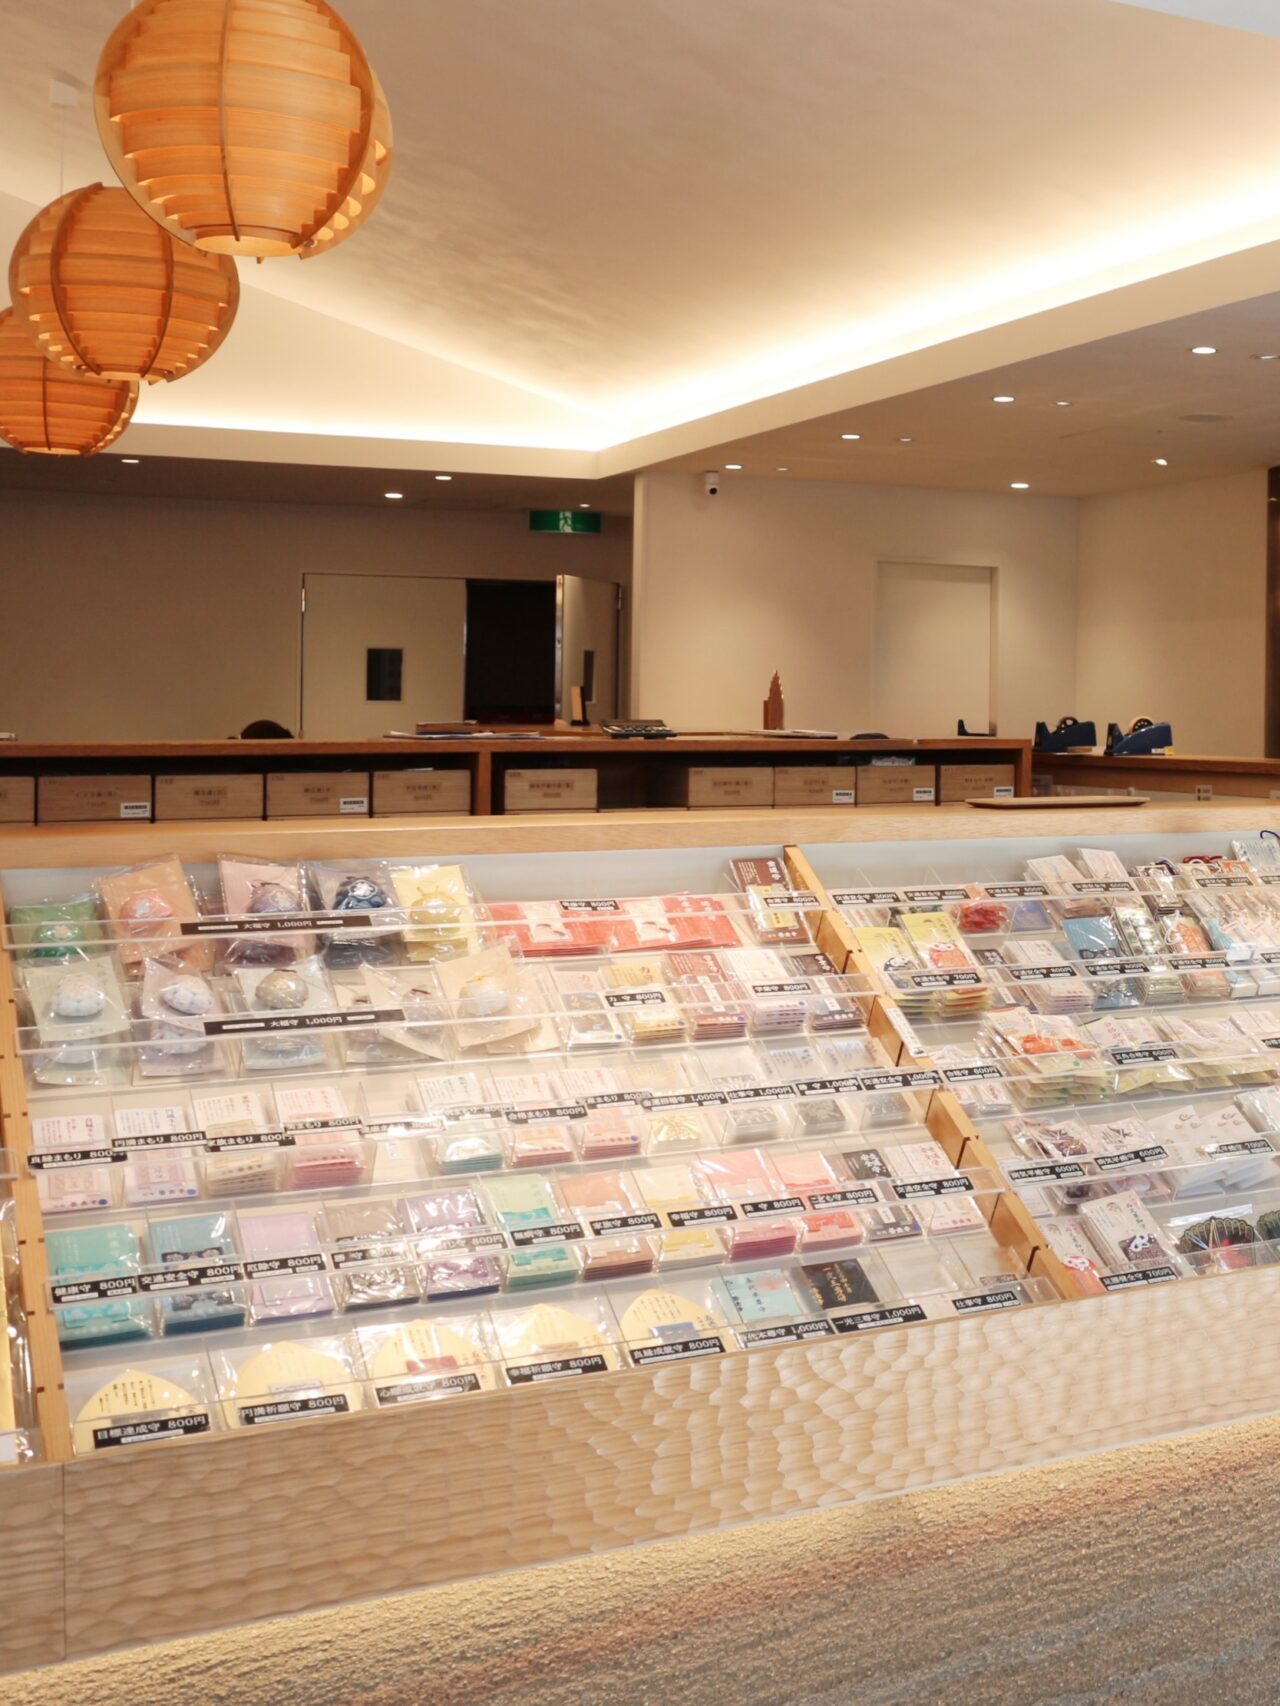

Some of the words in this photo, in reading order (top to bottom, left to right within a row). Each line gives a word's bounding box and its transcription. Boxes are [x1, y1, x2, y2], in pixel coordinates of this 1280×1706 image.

[244, 921, 270, 929] 大福守
[277, 920, 312, 928] 1,000円
[270, 1019, 298, 1027] 大福守
[306, 1016, 342, 1025] 1,000円
[690, 1092, 724, 1102] 1,000円
[759, 1086, 791, 1096] 1,000円
[556, 1106, 585, 1116] 800円
[170, 1131, 204, 1142] 800円
[1055, 1164, 1079, 1173] 600円
[897, 1182, 938, 1194] 交通安全守
[943, 1178, 968, 1188] 800円
[773, 1198, 801, 1208] 800円
[811, 1193, 841, 1204] こども守
[847, 1190, 872, 1200] 800円
[705, 1205, 732, 1216] 800円
[628, 1214, 657, 1225] 800円
[550, 1224, 579, 1235] 800円
[287, 1255, 321, 1267] 800円
[141, 1270, 199, 1285] 交通安全守
[206, 1263, 242, 1276] 800円
[54, 1284, 91, 1297] 健康守
[99, 1277, 135, 1290] 800円
[956, 1298, 982, 1308] 仕事守
[986, 1292, 1013, 1303] 800円
[885, 1307, 921, 1319] 1,000円
[791, 1322, 828, 1334] 1,000円
[689, 1338, 719, 1350] 800円
[569, 1356, 602, 1369] 800円
[443, 1375, 476, 1388] 800円
[241, 1402, 301, 1418] 円満祈願守
[308, 1395, 344, 1409] 800円
[97, 1422, 160, 1439] 目標達成守
[168, 1416, 206, 1429] 800円
